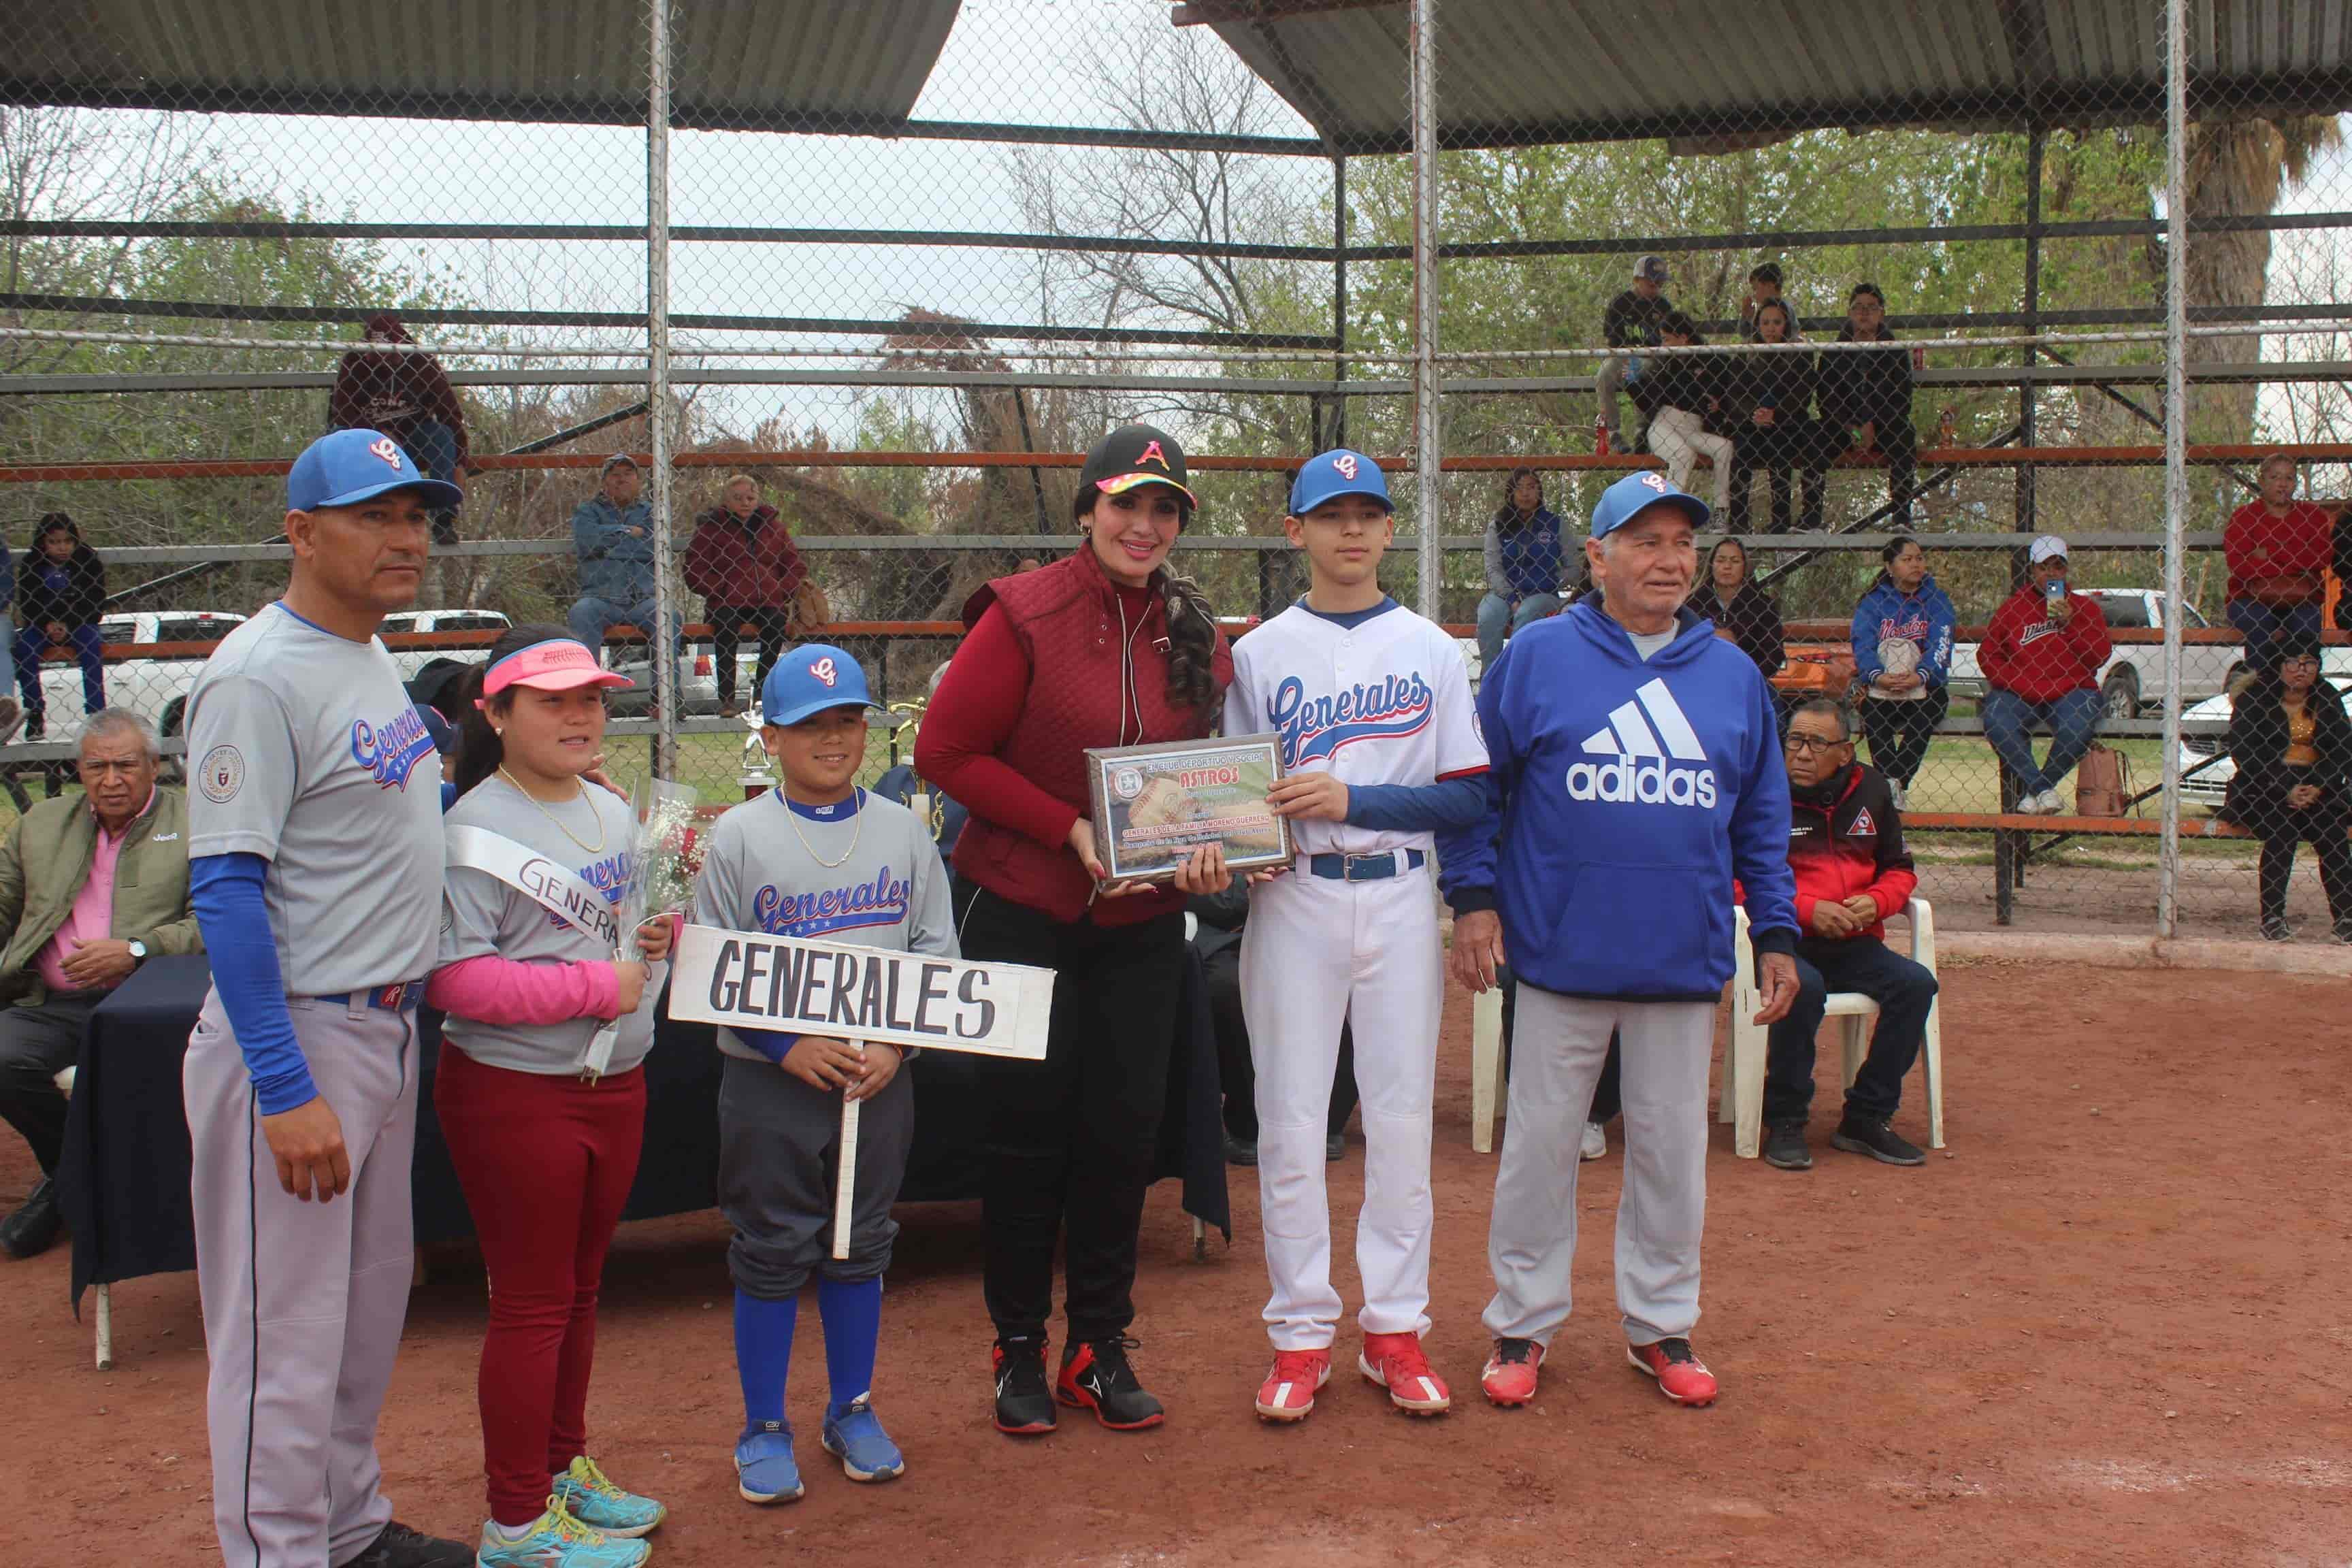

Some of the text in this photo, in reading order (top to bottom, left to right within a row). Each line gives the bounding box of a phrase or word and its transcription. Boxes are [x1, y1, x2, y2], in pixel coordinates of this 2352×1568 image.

[1134, 440, 1171, 472] A
[1267, 671, 1433, 769] Generales
[1158, 762, 1179, 771] CLUB
[1180, 755, 1226, 768] DEPORTIVO
[1235, 752, 1264, 764] SOCIAL
[1180, 767, 1240, 788] ASTROS
[1565, 753, 1716, 808] adidas
[1123, 826, 1162, 838] GENERALES
[1162, 825, 1171, 834] DE
[1181, 820, 1207, 831] FAMILIA
[1208, 817, 1235, 828] MORENO
[1236, 815, 1269, 824] GUERRERO
[753, 865, 911, 934] Generales
[708, 939, 996, 1039] GENERALES
